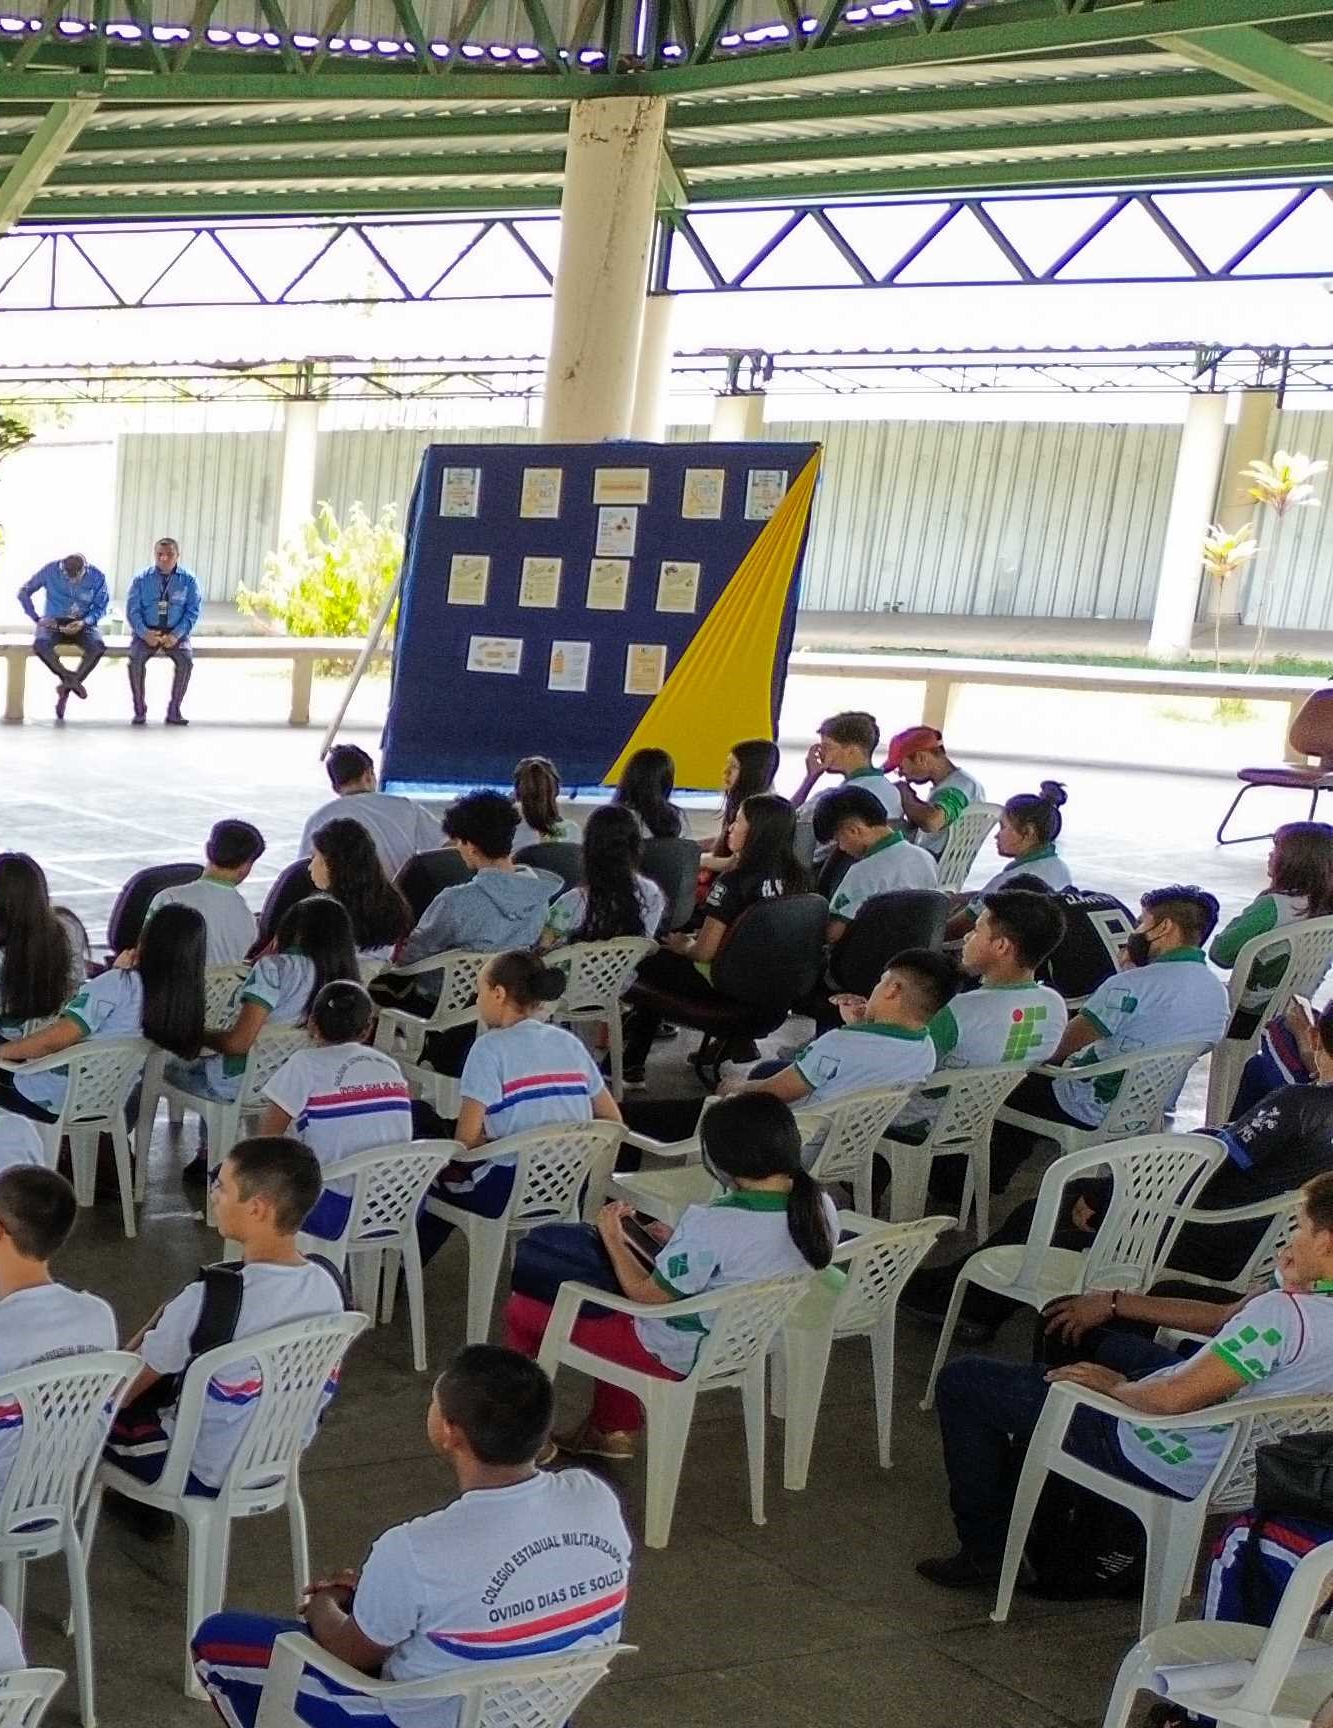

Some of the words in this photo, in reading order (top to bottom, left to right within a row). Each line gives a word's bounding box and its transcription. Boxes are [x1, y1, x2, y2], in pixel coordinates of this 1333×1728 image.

[481, 1561, 516, 1606] COLÉGIO
[513, 1535, 561, 1567] ESTADUAL
[561, 1532, 623, 1564] MILITARIZADO
[488, 1599, 535, 1623] OVIDIO
[537, 1588, 568, 1609] DIAS
[570, 1582, 588, 1598] DE
